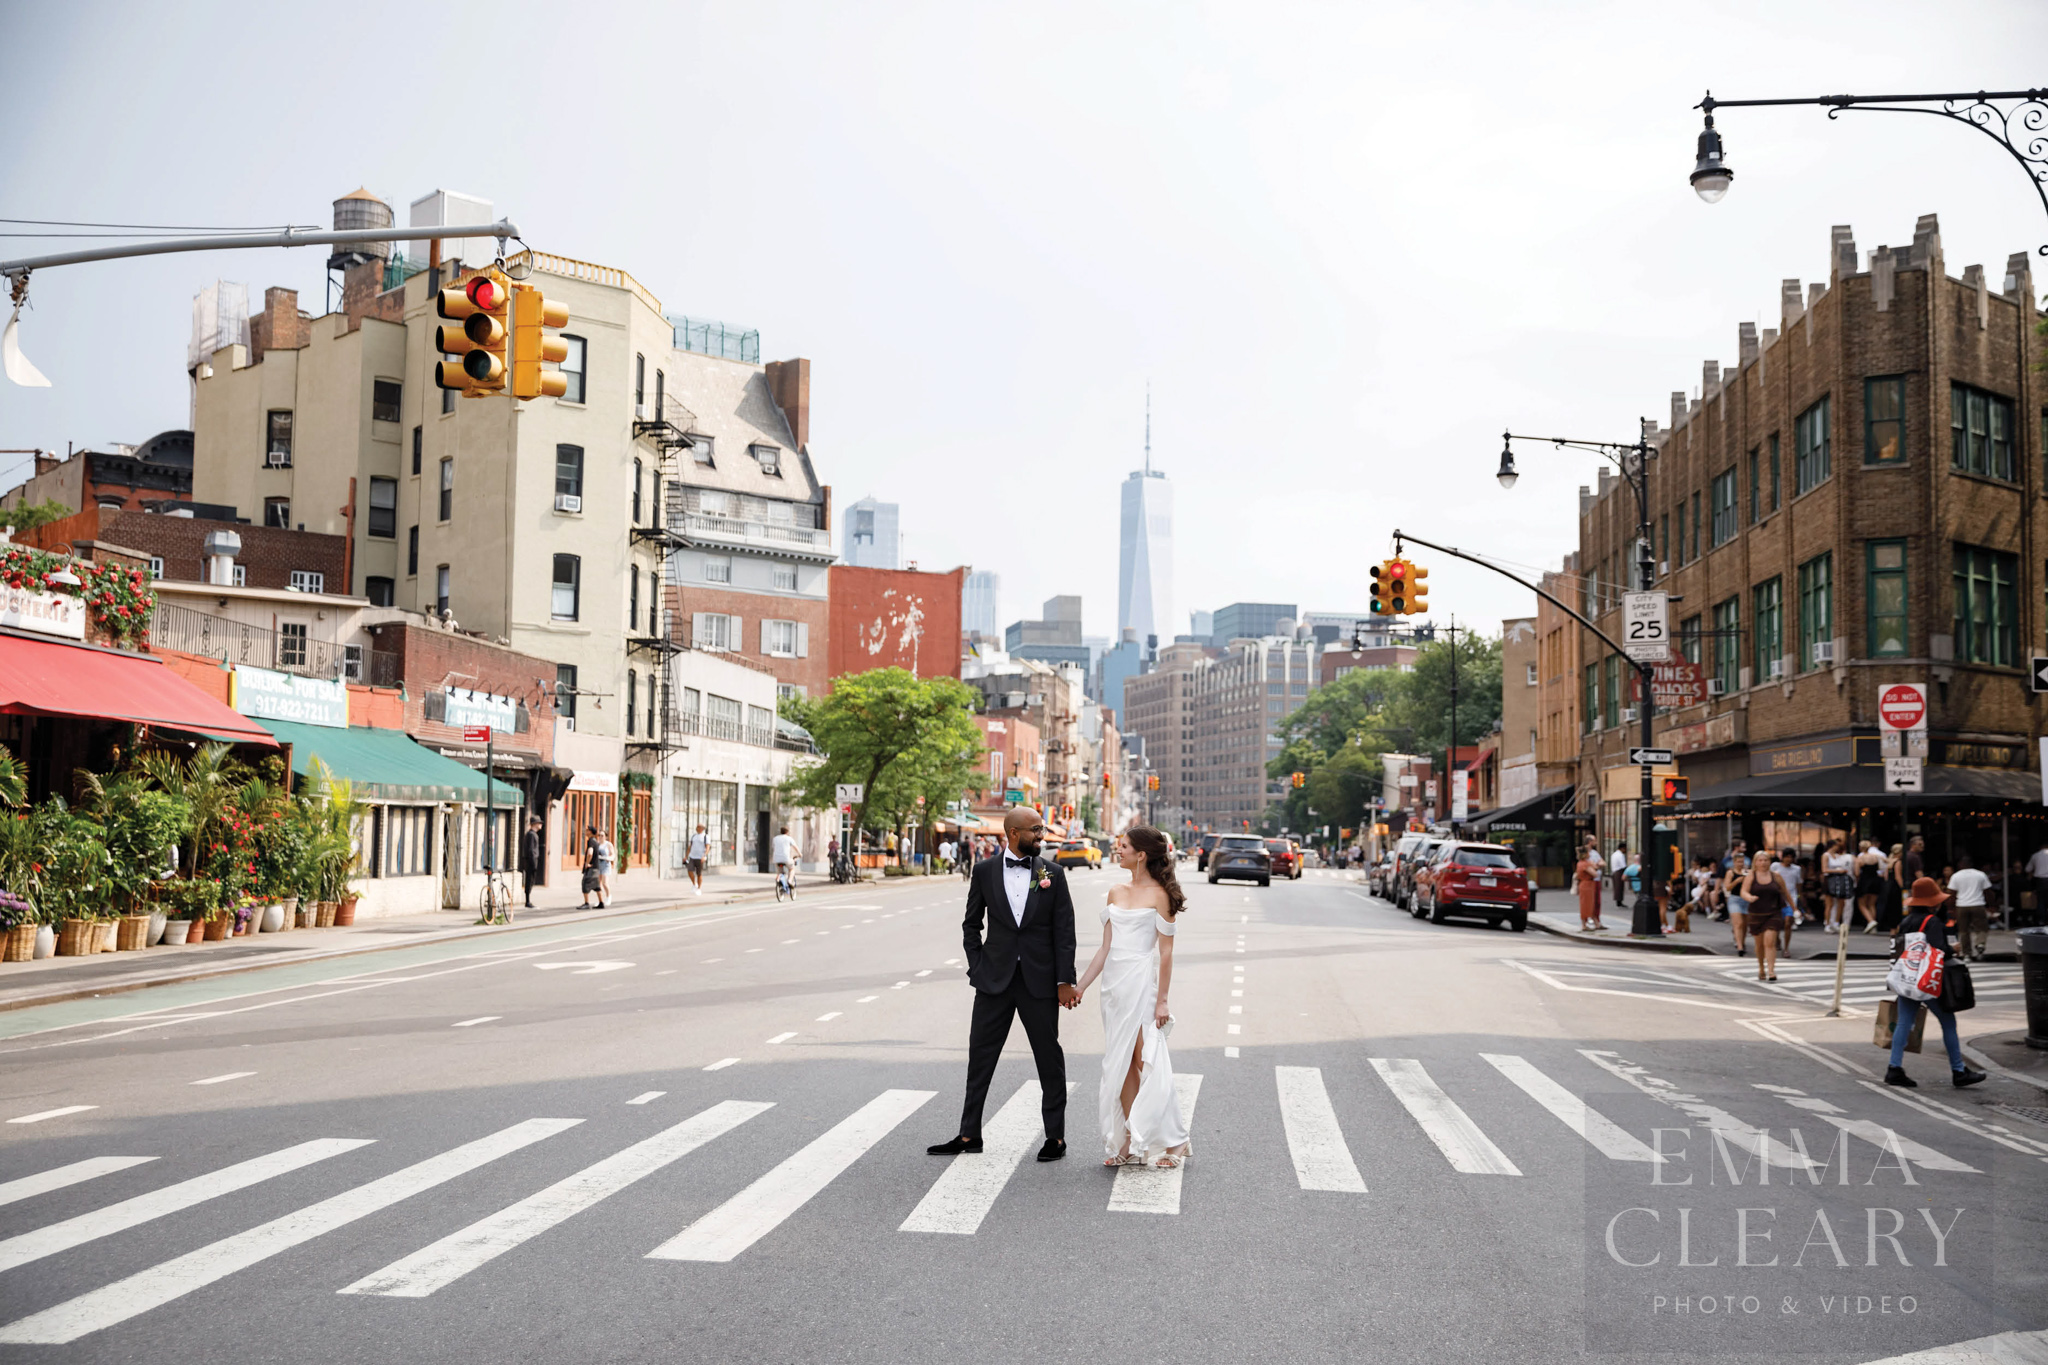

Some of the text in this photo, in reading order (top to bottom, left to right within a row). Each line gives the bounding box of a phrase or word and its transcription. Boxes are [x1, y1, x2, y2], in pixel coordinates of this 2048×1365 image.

[1630, 620, 1662, 639] 25
[240, 671, 343, 703] BUILDING FOR SALE
[1901, 693, 1918, 701] NOT
[255, 695, 330, 721] 917-922-7211
[1889, 713, 1916, 721] ENTER
[1893, 760, 1913, 768] ALL
